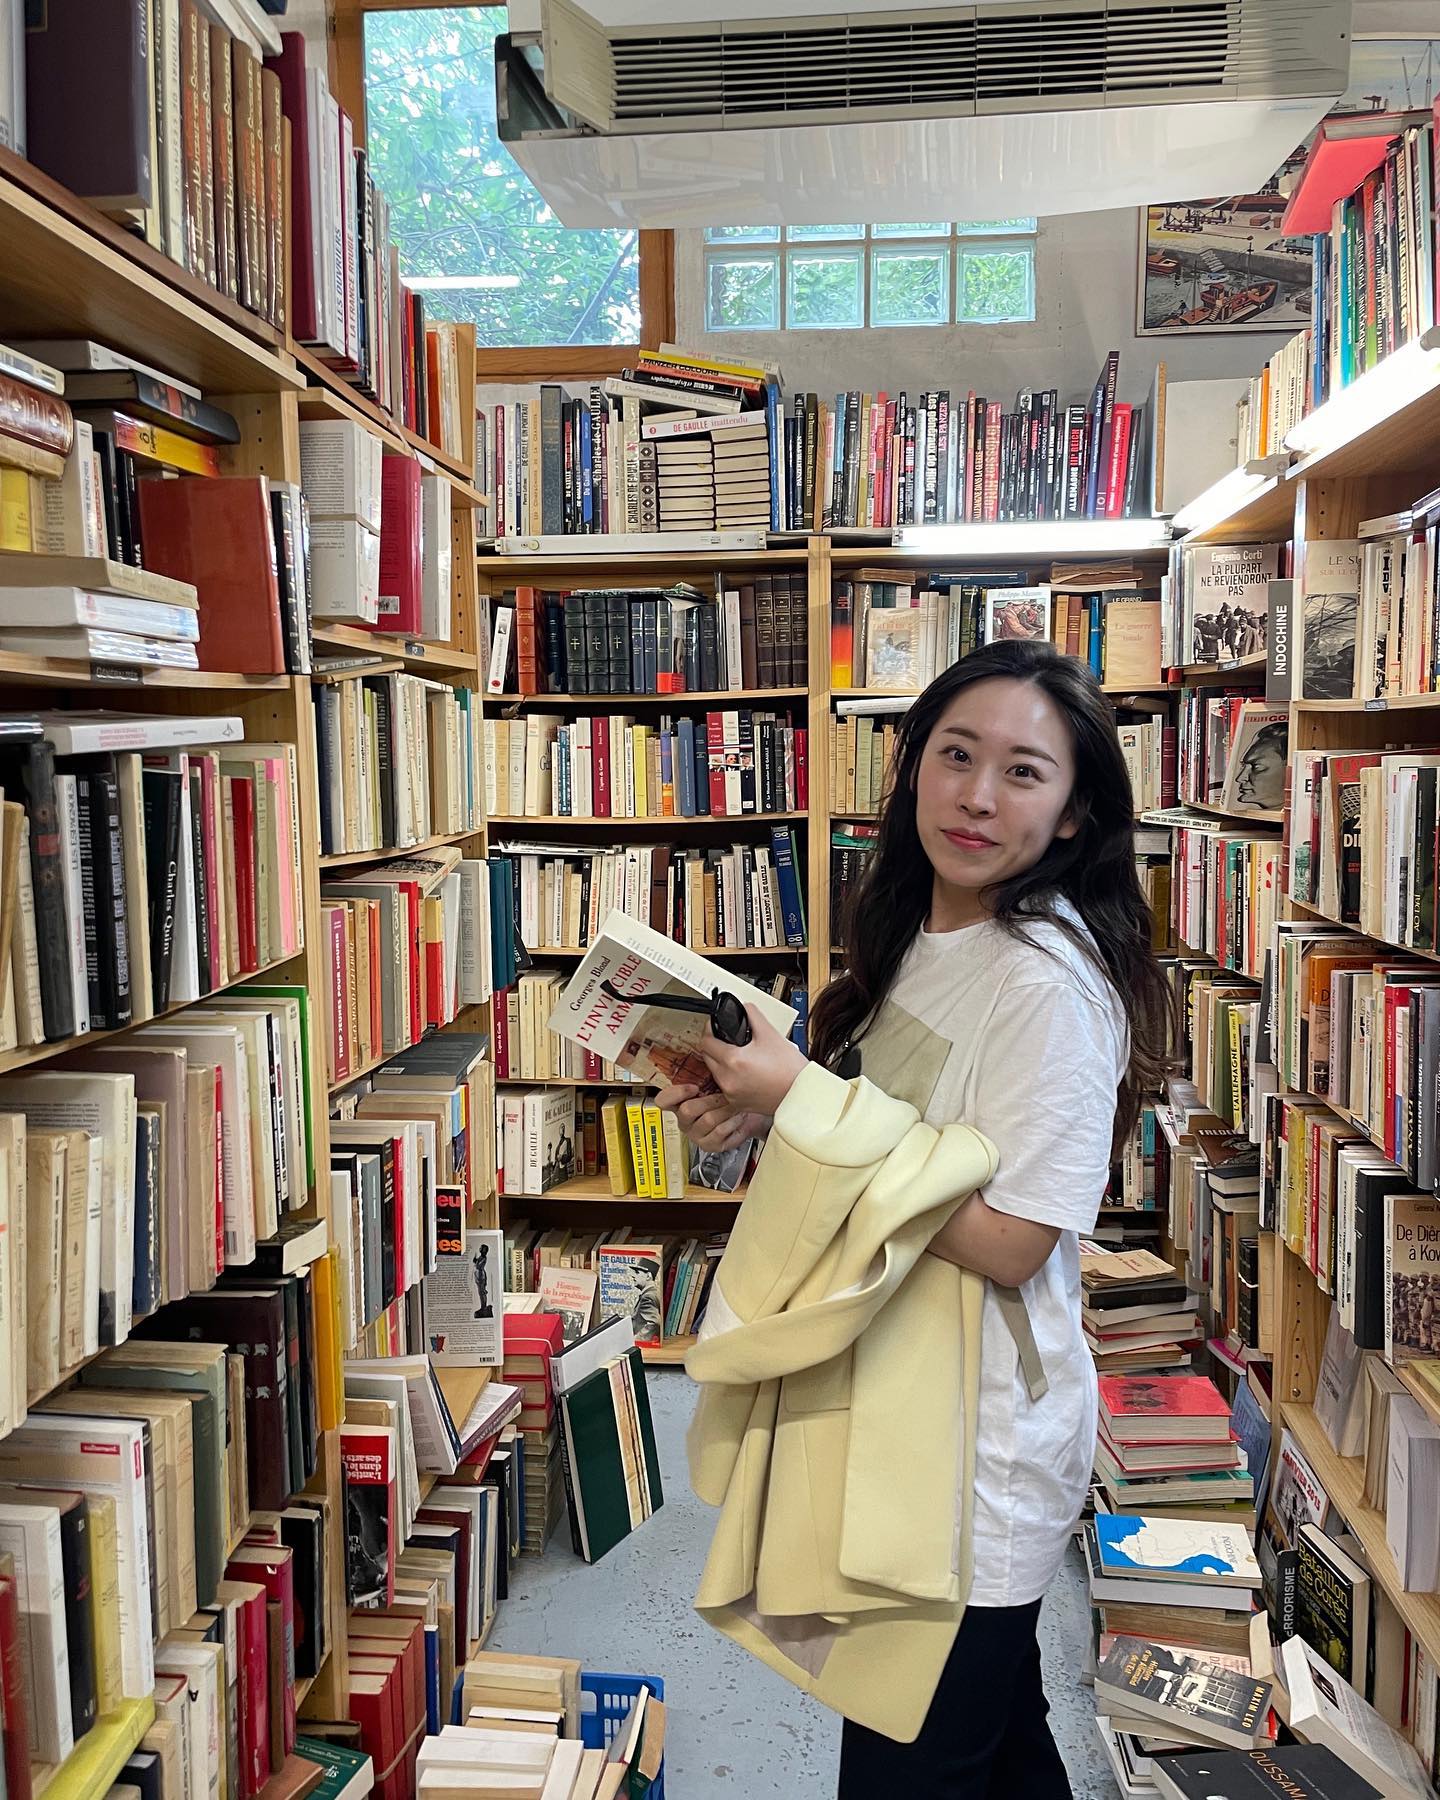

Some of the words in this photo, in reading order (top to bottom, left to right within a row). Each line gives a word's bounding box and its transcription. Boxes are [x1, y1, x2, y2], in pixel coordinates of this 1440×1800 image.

[335, 228, 344, 294] OUVRIERS
[347, 233, 355, 272] ROUGE
[335, 296, 344, 323] LES
[348, 278, 356, 322] FRANCE
[348, 323, 356, 338] LA
[591, 387, 601, 430] GAULLE
[928, 393, 938, 410] Les
[673, 424, 683, 432] DE
[683, 420, 708, 431] GAULLE
[711, 415, 749, 427] inattendu
[939, 401, 948, 435] PANZER
[939, 436, 947, 451] LES
[522, 459, 528, 467] DE
[592, 447, 602, 481] Charles
[627, 459, 637, 483] GAULLE
[627, 484, 638, 493] DE
[627, 493, 638, 524] CHARLES
[1211, 552, 1241, 563] Eugenio
[1243, 550, 1264, 561] Corti
[1328, 556, 1343, 566] LE
[1201, 576, 1213, 587] NE
[1214, 573, 1273, 586] REVIENDRONT
[1211, 565, 1223, 576] LA
[1224, 563, 1262, 576] PLUPART
[1228, 585, 1244, 597] PAS
[1273, 604, 1288, 677] INDOCHINE
[1268, 714, 1290, 722] GO
[67, 783, 80, 846] ESPAGNOLS
[71, 847, 80, 871] LES
[166, 861, 178, 912] Charles
[163, 915, 174, 956] Quint
[1413, 917, 1421, 933] AO
[393, 934, 401, 965] MAX
[569, 978, 597, 1012] Georges
[590, 955, 611, 978] Blond
[576, 954, 643, 1042] L'INVICIBLE
[606, 976, 653, 1035] ARMDA
[350, 995, 358, 1043] RAYMOND
[337, 1035, 345, 1059] TROP
[1231, 1048, 1241, 1112] L'ALLEMAGNE
[530, 1131, 538, 1158] GAULLE
[530, 1158, 538, 1168] DE
[1396, 1224, 1413, 1242] De
[601, 1255, 610, 1264] DE
[611, 1256, 637, 1265] GAULLE
[1408, 1245, 1417, 1261] à
[347, 1455, 365, 1464] arts
[360, 1463, 382, 1472] dans
[366, 1455, 382, 1464] des
[1305, 1483, 1321, 1512] 2015
[1299, 1543, 1349, 1611] Bataillon
[1300, 1562, 1314, 1587] de
[1249, 1686, 1266, 1712] MAXIM
[1241, 1713, 1256, 1729] LEO
[1249, 1751, 1308, 1800] OUSSAM
